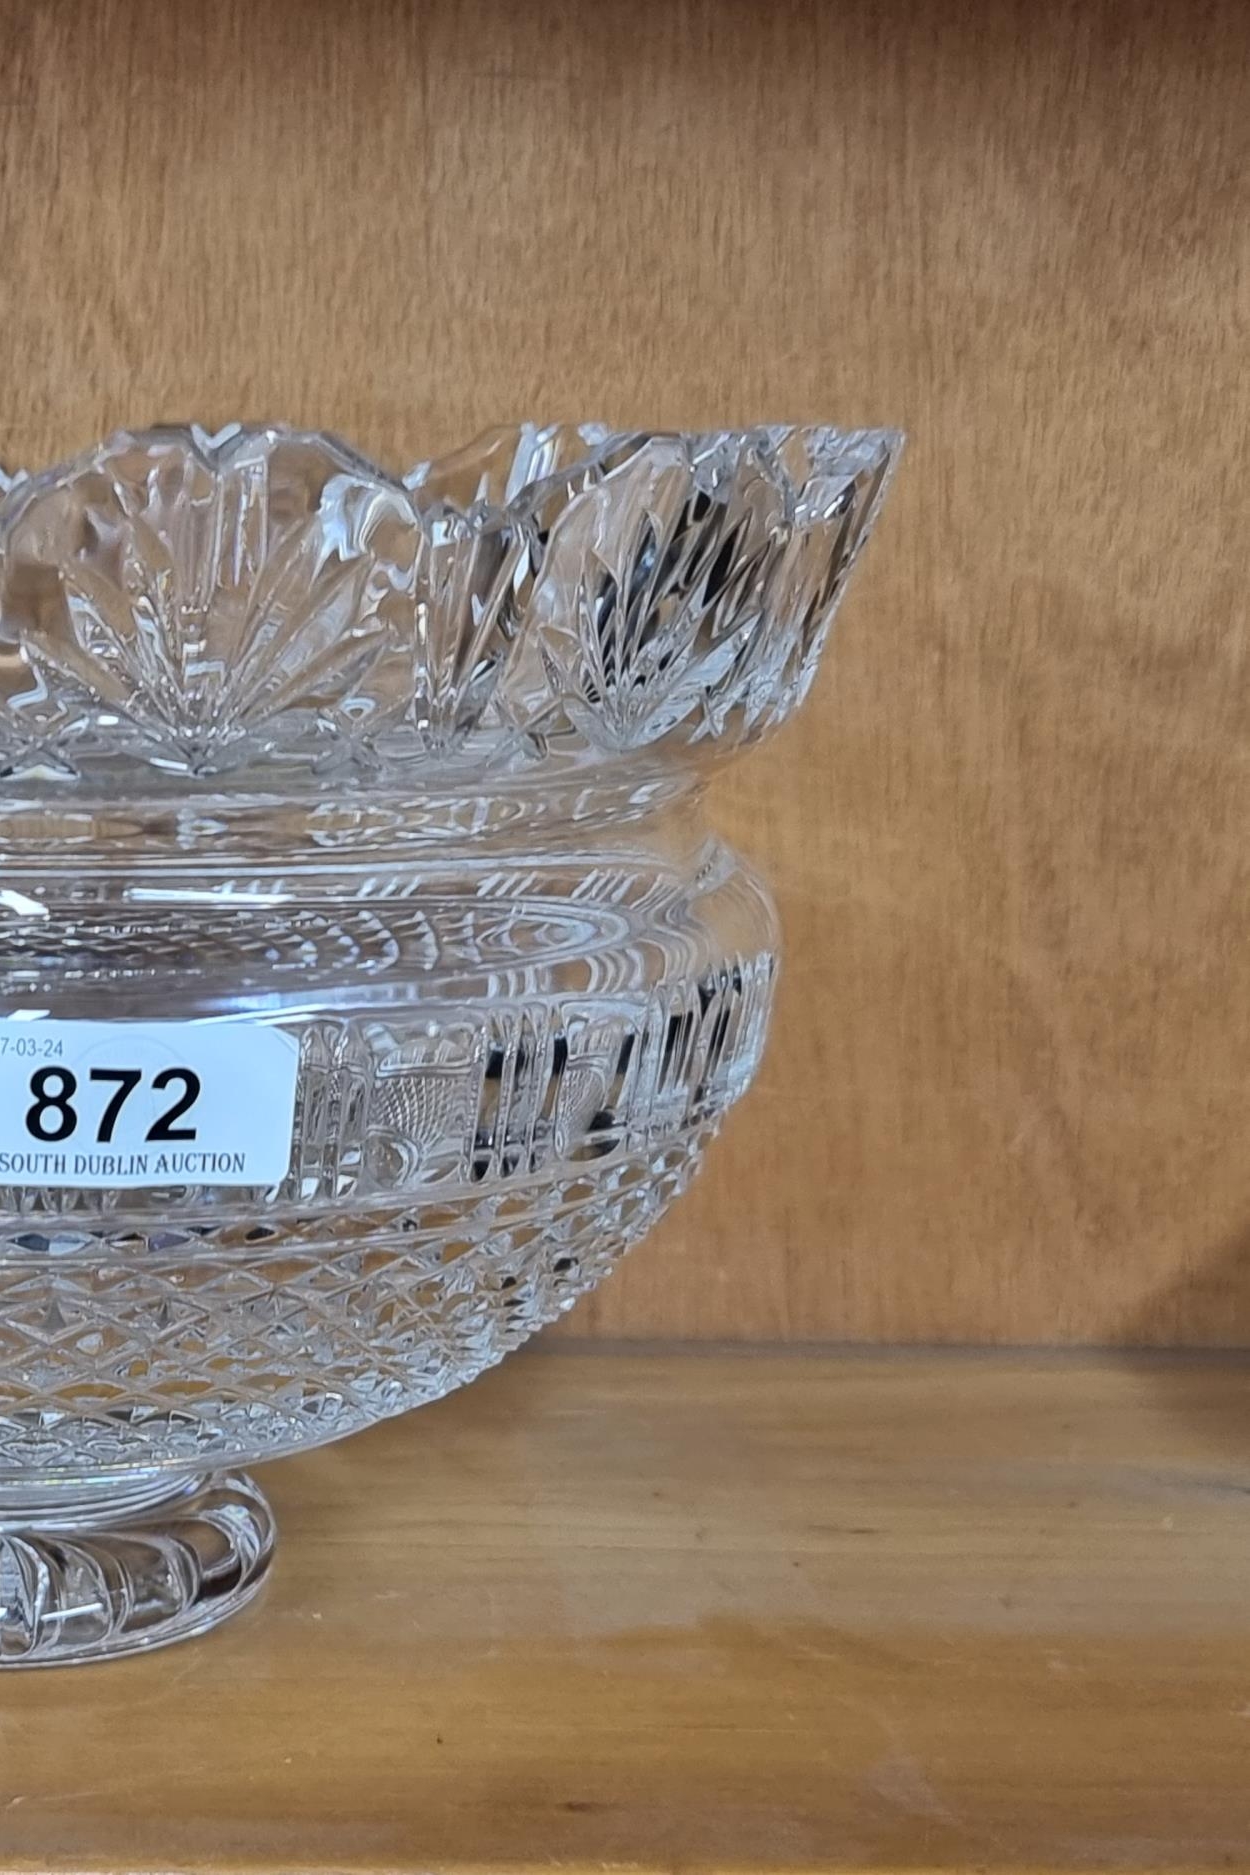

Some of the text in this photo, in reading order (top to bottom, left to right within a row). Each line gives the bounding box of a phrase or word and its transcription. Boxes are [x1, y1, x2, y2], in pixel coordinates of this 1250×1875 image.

[25, 1066, 201, 1143] 872
[74, 1154, 149, 1176] DUBLIN
[154, 1152, 246, 1174] AUCTION
